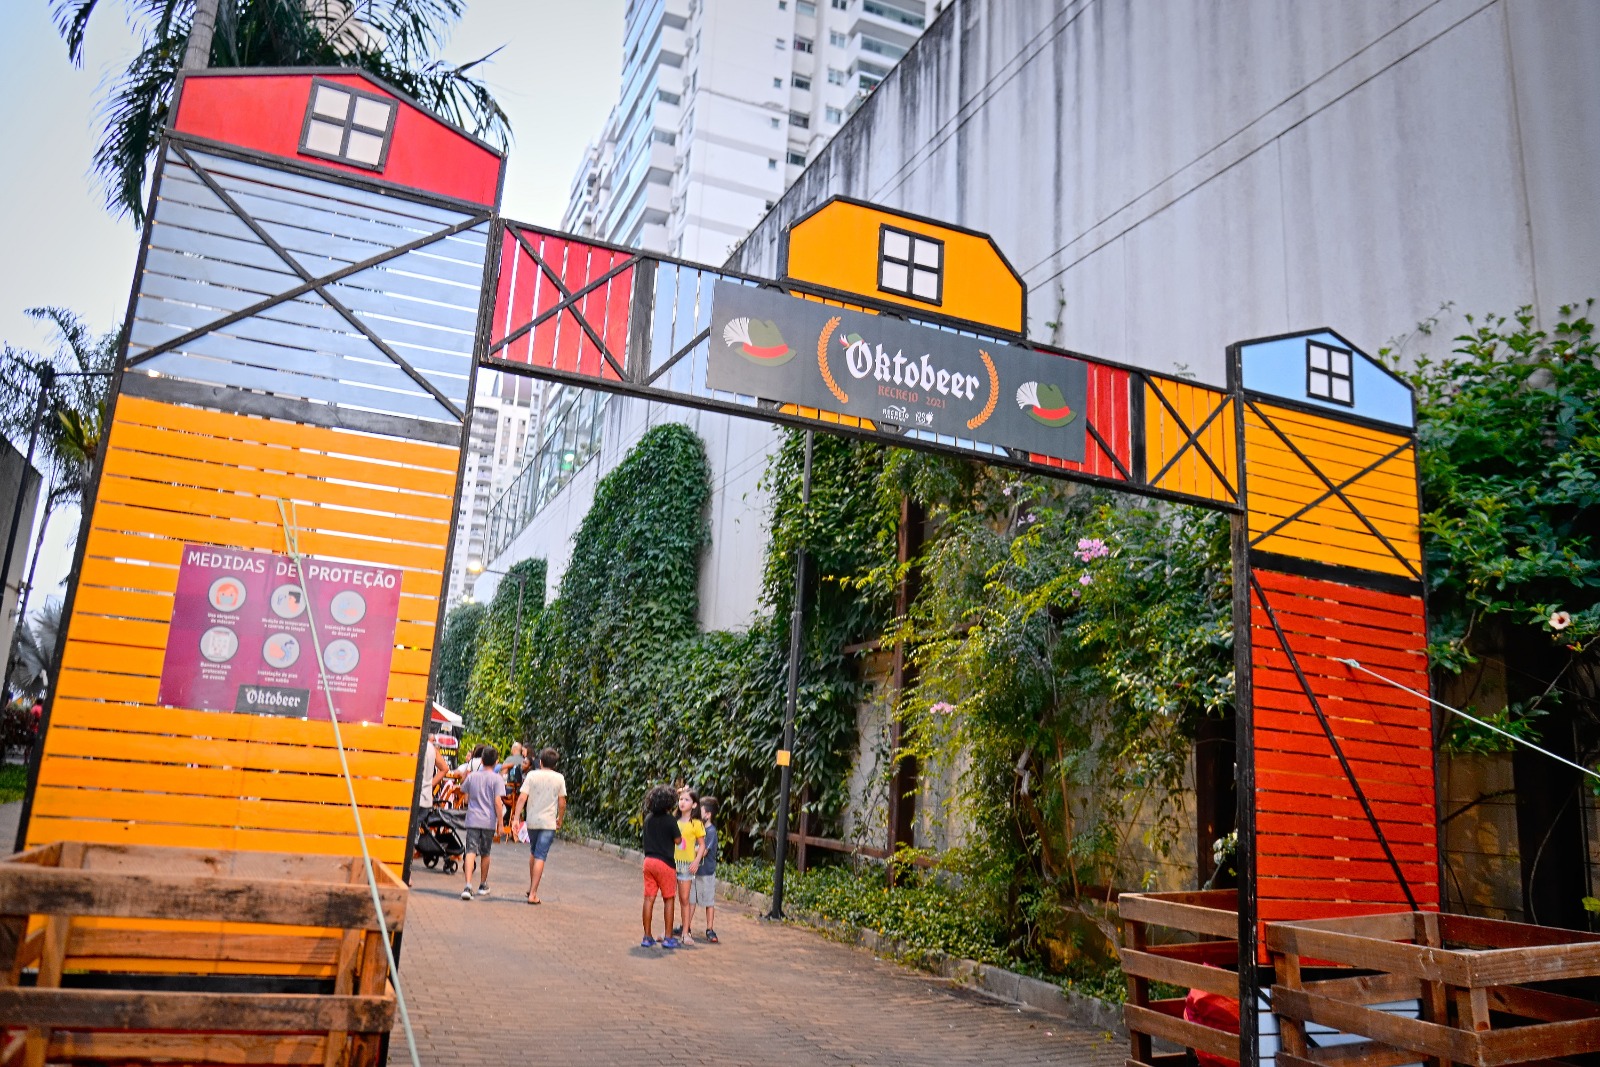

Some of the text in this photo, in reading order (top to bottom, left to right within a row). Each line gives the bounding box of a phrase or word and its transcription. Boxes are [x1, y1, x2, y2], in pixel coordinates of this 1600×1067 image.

[845, 339, 980, 401] Oktobeer
[878, 384, 946, 408] RECREIO 2021
[188, 551, 396, 589] MEDIDAS DE PROTEÇÃO
[246, 688, 300, 708] Oktobeer
